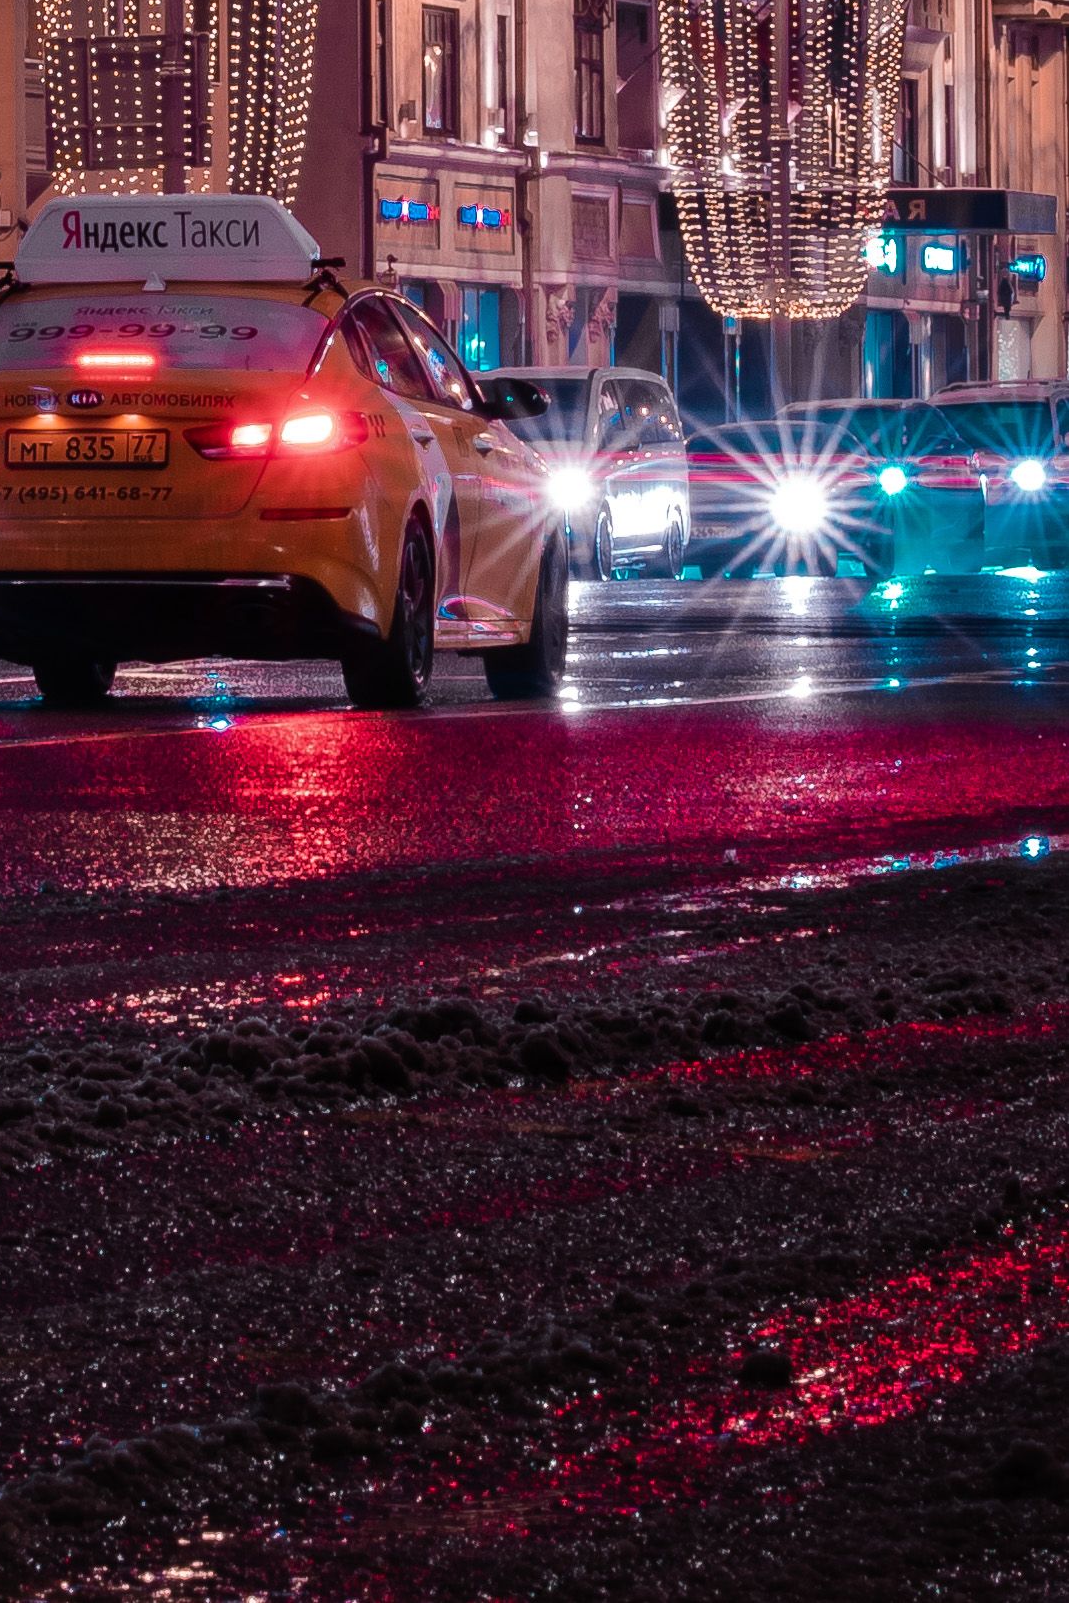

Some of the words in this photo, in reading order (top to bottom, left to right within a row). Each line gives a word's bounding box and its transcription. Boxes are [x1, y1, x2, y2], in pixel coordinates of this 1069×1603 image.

[62, 210, 169, 253] Яндекс
[174, 211, 260, 247] Такси
[74, 306, 152, 316] Яндекс
[7, 324, 259, 343] 999-99-99
[71, 392, 100, 405] KIA
[110, 393, 236, 409] АВТОМОБИЛЯХ
[20, 441, 53, 462] МТ
[65, 436, 115, 461] 835
[132, 435, 157, 454] 77
[18, 485, 68, 504] (495)
[74, 486, 173, 501] 641-68-77
